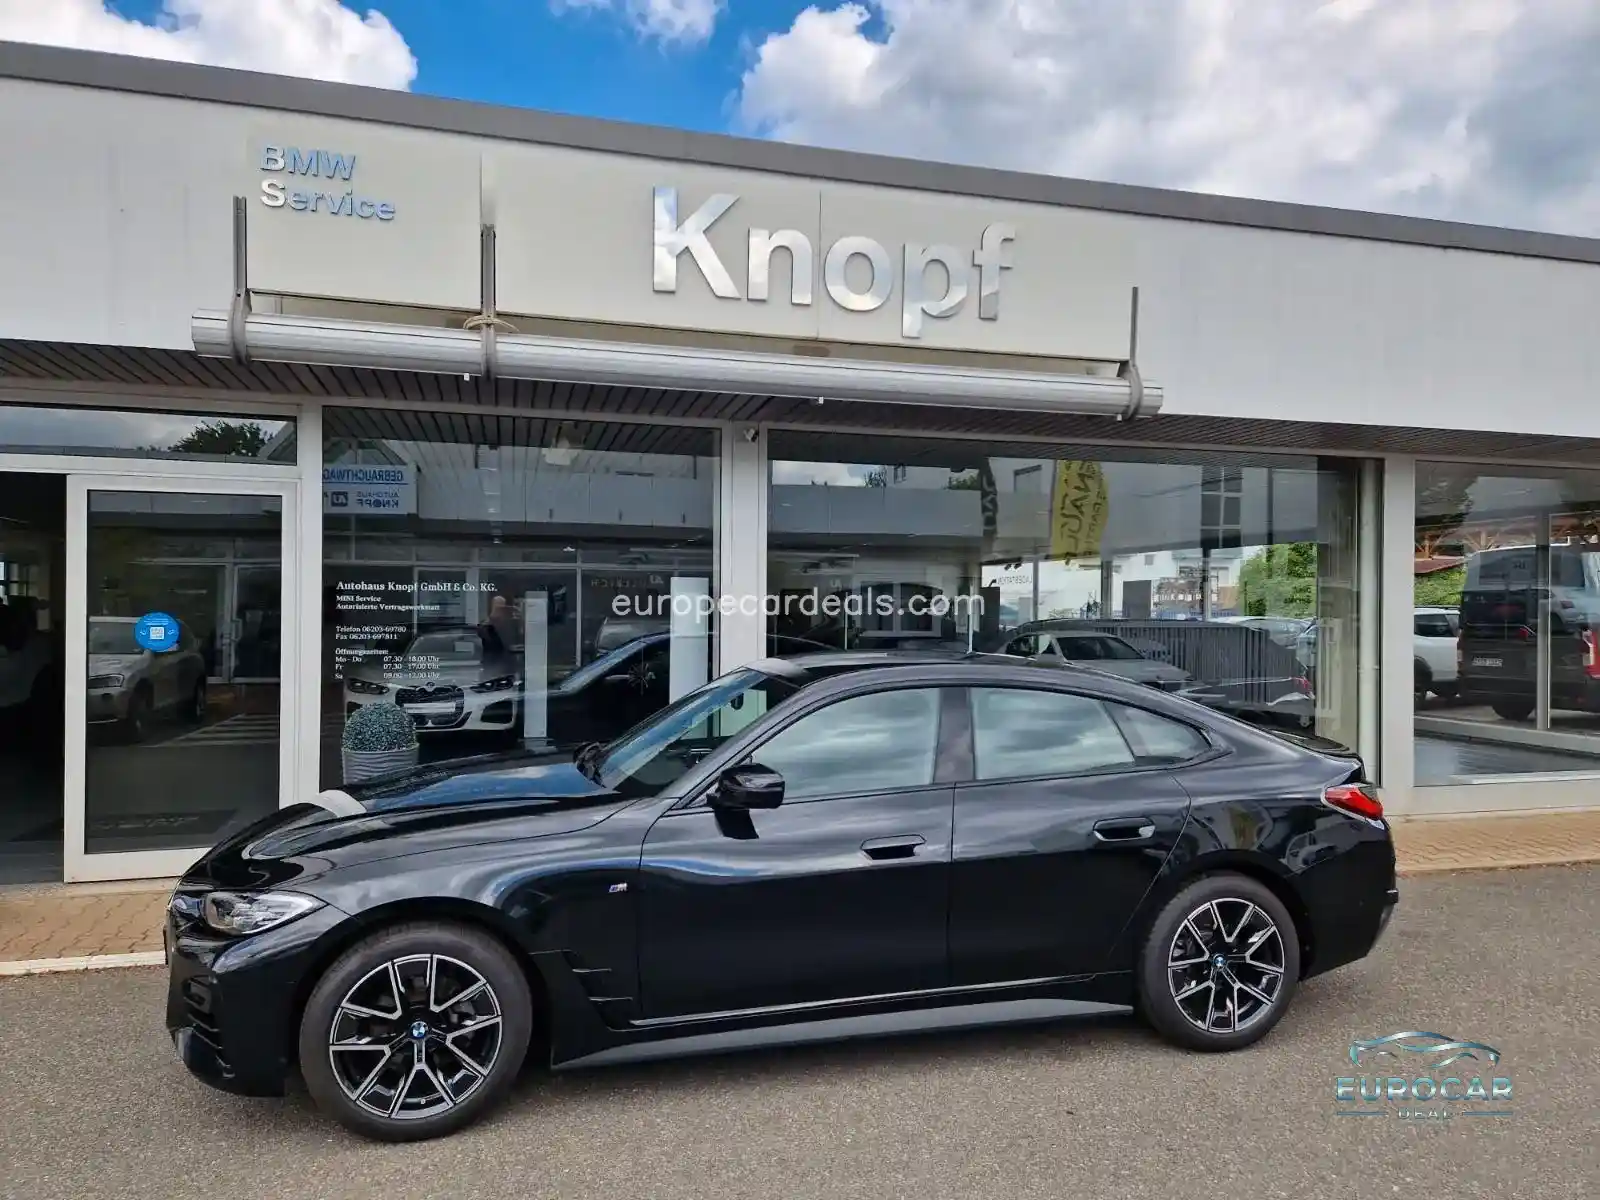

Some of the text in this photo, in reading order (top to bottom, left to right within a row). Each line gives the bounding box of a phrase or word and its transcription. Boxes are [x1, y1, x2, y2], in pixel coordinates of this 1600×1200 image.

[260, 145, 356, 180] BMW
[260, 178, 396, 221] Service
[652, 184, 1016, 339] Knopf
[336, 581, 498, 593] Autohaus Knopf GmbH & Co. KG.
